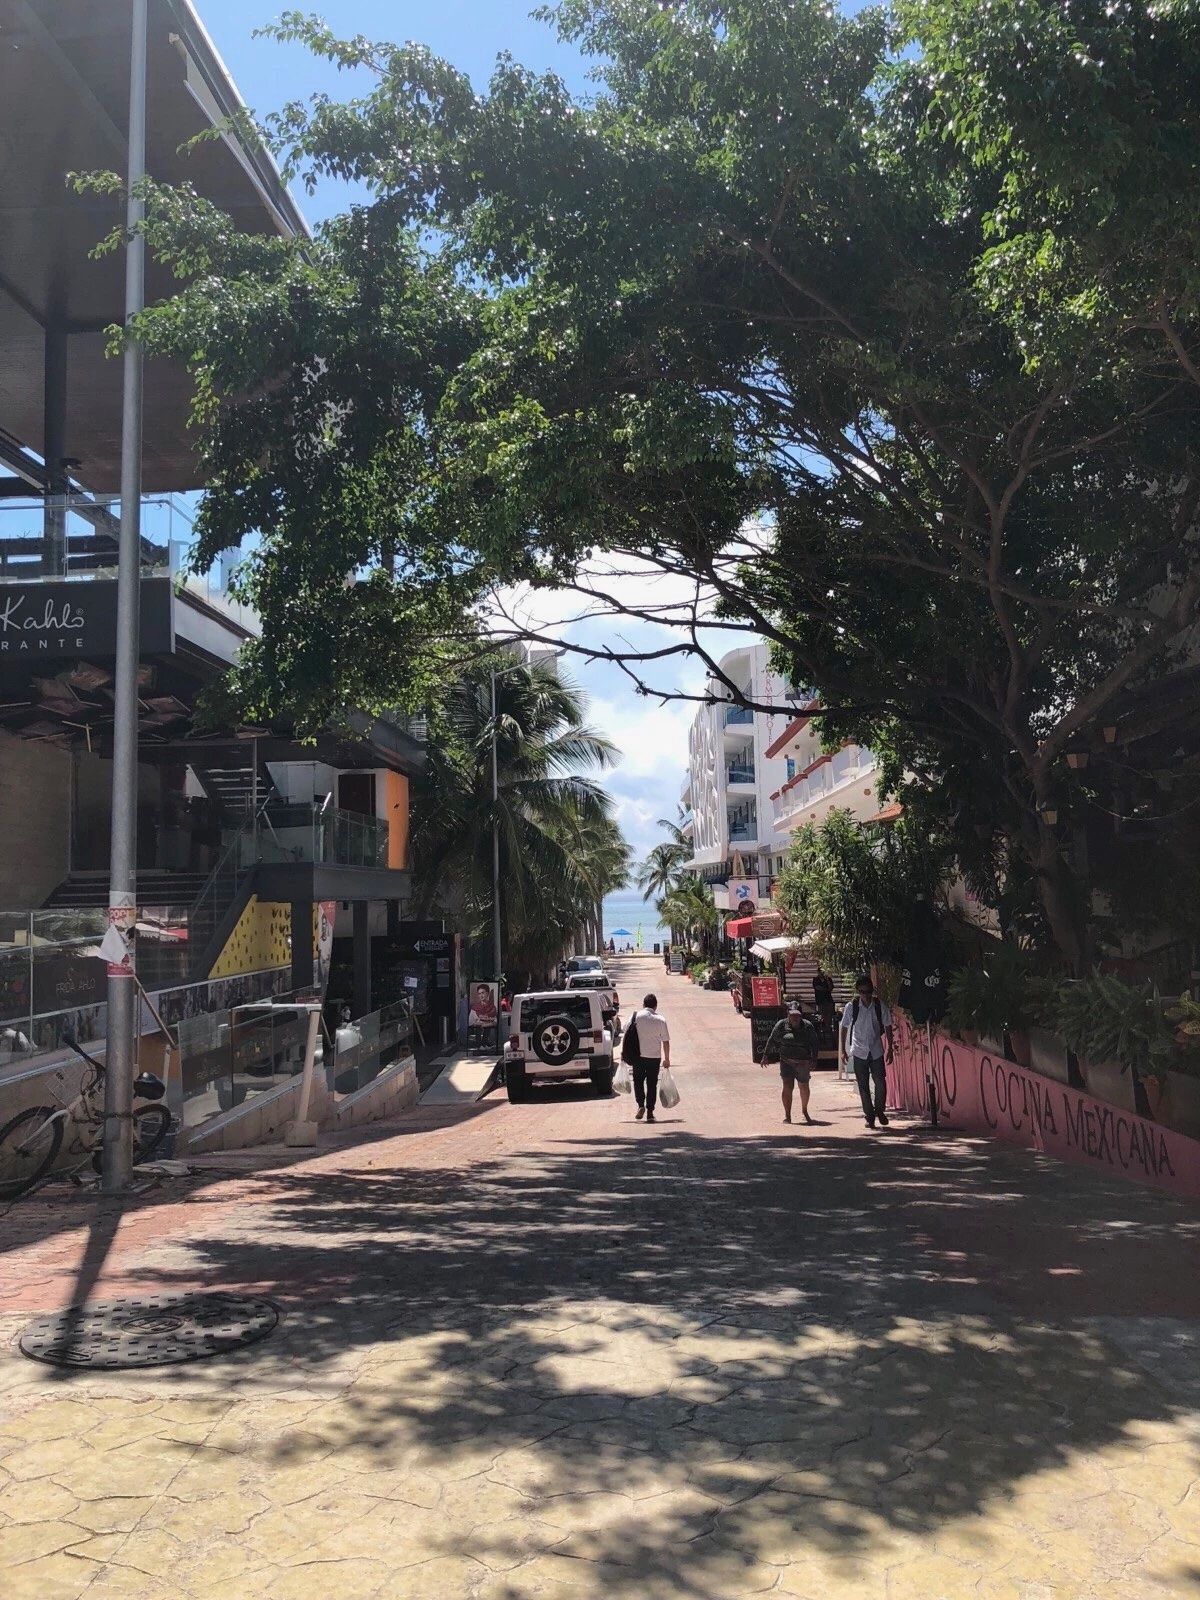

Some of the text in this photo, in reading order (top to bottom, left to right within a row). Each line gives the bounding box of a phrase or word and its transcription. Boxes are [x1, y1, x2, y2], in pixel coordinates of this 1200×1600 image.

[0, 595, 84, 631] Kahlo
[1, 638, 83, 650] RANTE
[980, 1055, 1058, 1140] COCINA
[1063, 1093, 1176, 1177] MEXICANA
